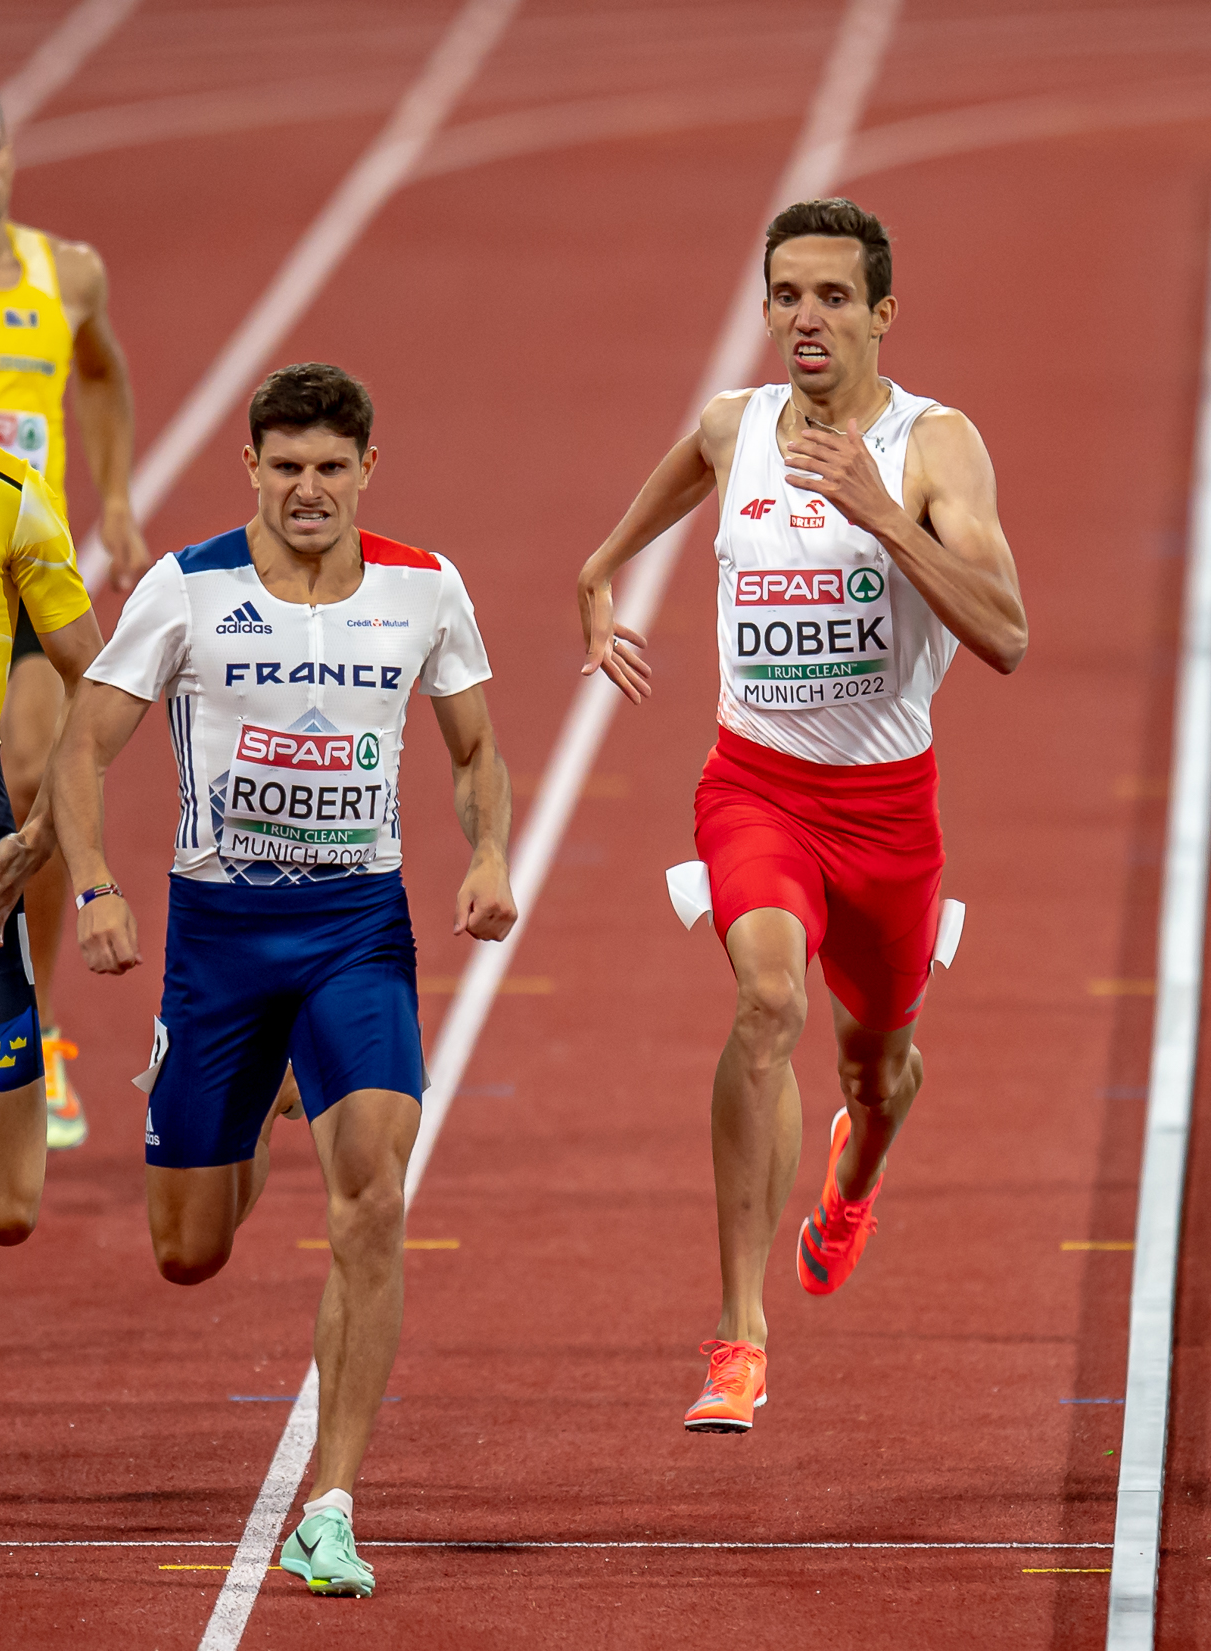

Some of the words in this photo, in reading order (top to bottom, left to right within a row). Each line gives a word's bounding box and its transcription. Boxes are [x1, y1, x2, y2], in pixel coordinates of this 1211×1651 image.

[740, 498, 777, 520] 4F
[738, 574, 841, 602] SPAR
[215, 621, 273, 635] adidas
[382, 619, 410, 628] Mutuel
[737, 616, 889, 658] DOBEK
[225, 661, 403, 690] FRANCE
[767, 667, 772, 678] I
[774, 666, 803, 679] RUN
[744, 684, 825, 704] MUNICH
[832, 676, 885, 700] 2022
[241, 730, 350, 767] SPAR
[231, 775, 383, 821] ROBERT
[271, 825, 301, 840] RUN
[232, 833, 319, 864] MUNICH
